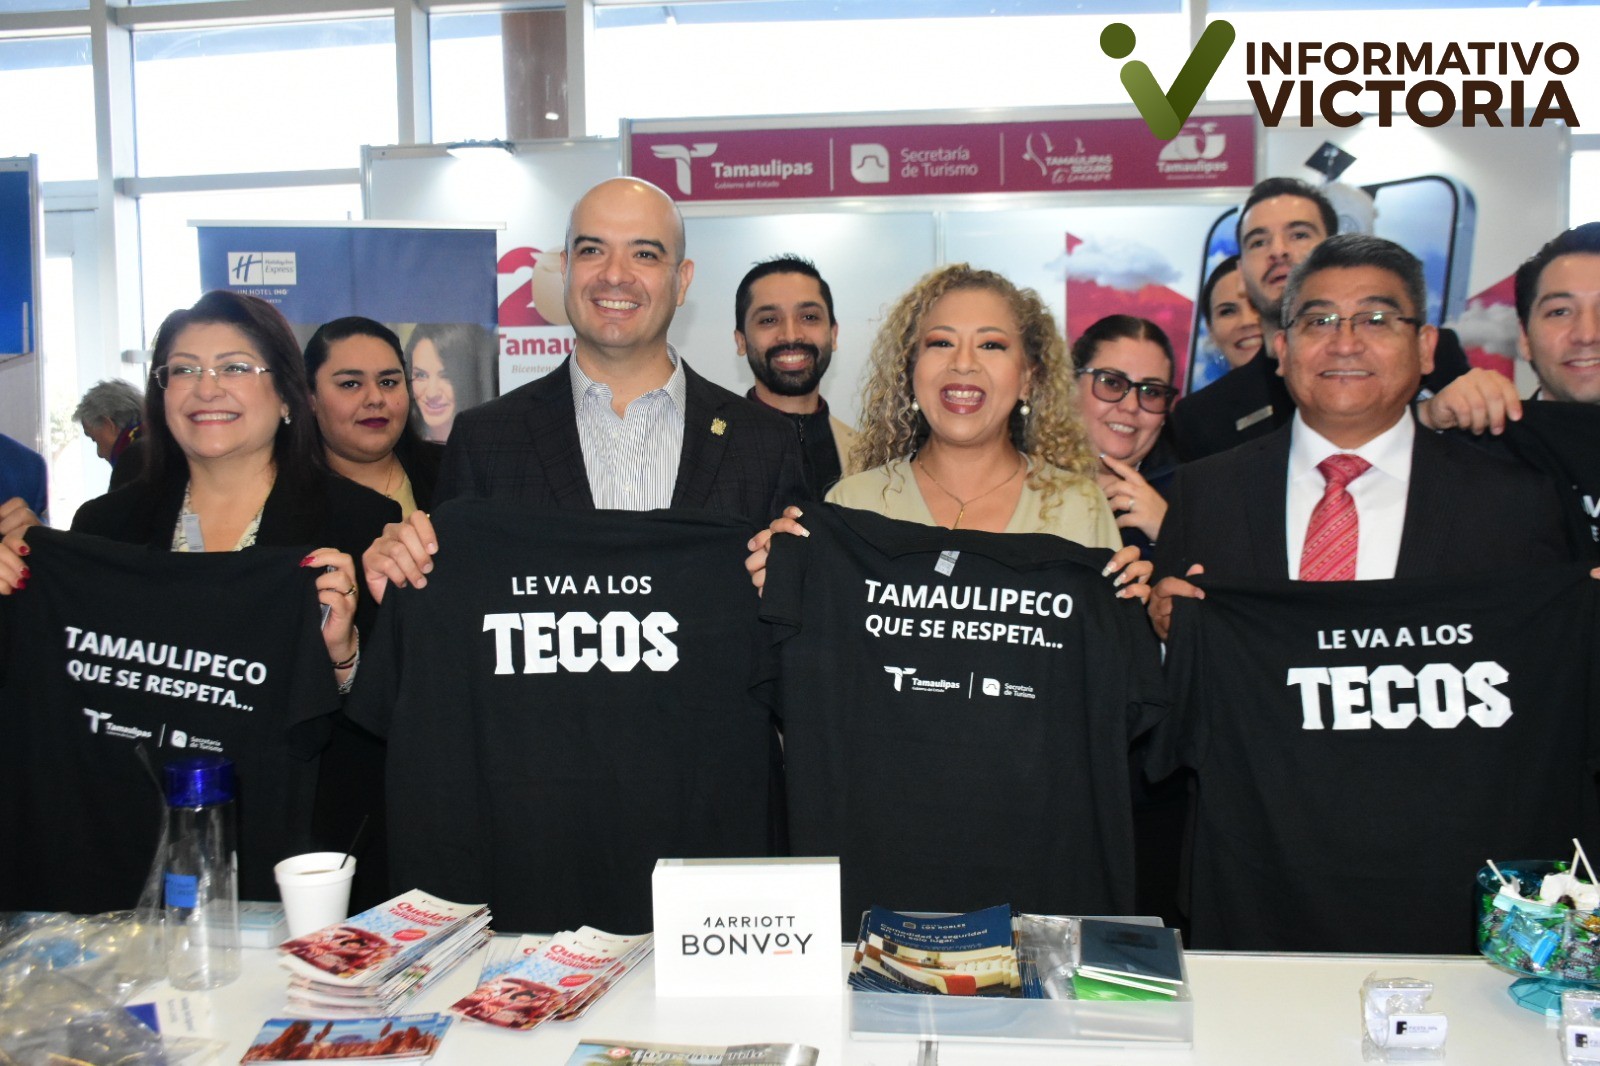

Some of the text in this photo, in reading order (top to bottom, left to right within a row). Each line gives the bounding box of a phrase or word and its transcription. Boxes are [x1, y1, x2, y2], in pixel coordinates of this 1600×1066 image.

[901, 145, 970, 163] Secretaría
[711, 159, 814, 180] Tamaulipas
[901, 162, 979, 178] de Turismo
[1156, 161, 1228, 175] Tamaulipas
[265, 265, 294, 274] Express
[498, 333, 576, 356] Tamau
[512, 575, 652, 595] LE VA A LOS
[865, 579, 1074, 619] TAMAULIPECO
[865, 614, 1064, 650] QUE SE RESPETA...
[1317, 624, 1474, 650] LE VA A LOS
[482, 611, 680, 674] TECOS
[64, 626, 268, 686] TAMAULIPECO
[67, 659, 254, 712] QUE SE RESPETA...
[912, 677, 960, 690] Tamaulipas
[1013, 690, 1036, 699] Turismo
[1286, 661, 1514, 731] TECOS
[106, 722, 152, 738] Tamaulipas
[703, 916, 796, 928] MARRIOTT
[880, 923, 932, 939] Comodidad
[942, 929, 988, 940] seguridad
[682, 933, 813, 956] BONVOY
